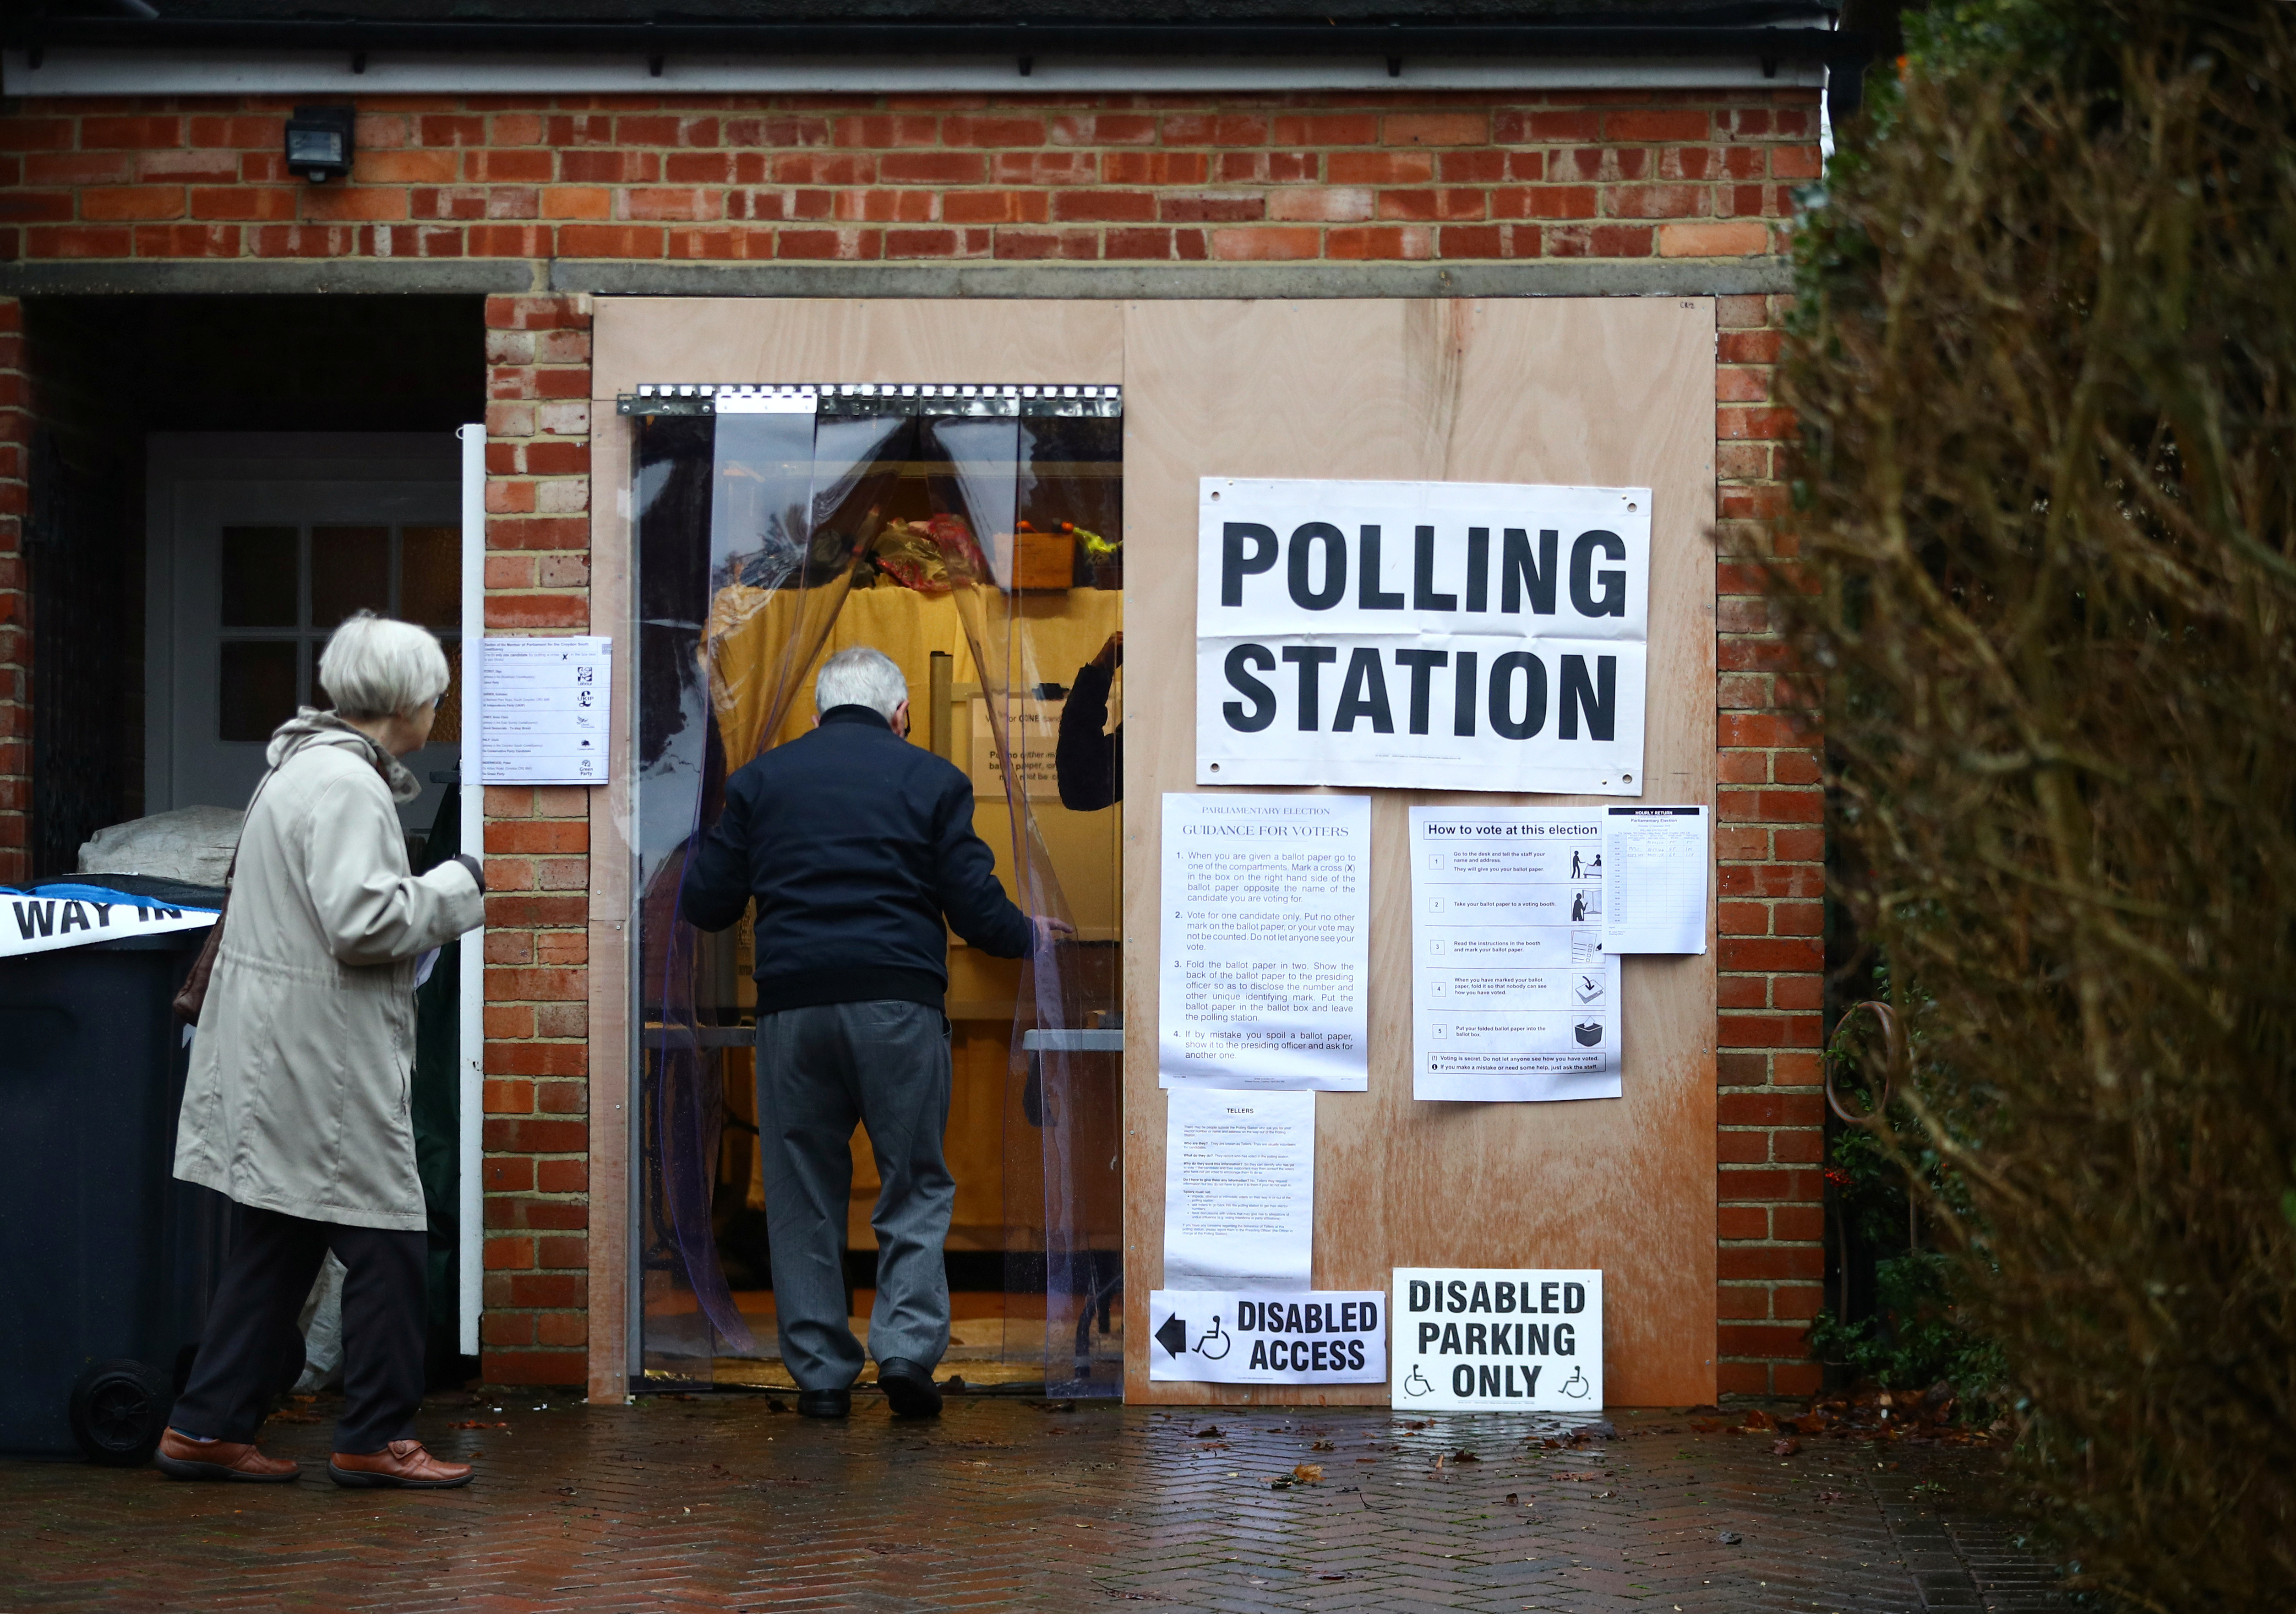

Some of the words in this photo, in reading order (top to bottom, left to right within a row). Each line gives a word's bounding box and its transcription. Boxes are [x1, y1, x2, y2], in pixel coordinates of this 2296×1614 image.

[1222, 522, 1625, 617] POLLING
[1223, 644, 1616, 741] STATION
[1183, 825, 1254, 835] GUIDANCE
[1260, 826, 1287, 836] FOR
[1292, 826, 1348, 836] VOTERS
[1429, 824, 1456, 834] How
[1459, 825, 1472, 834] to
[1476, 825, 1501, 834] vote
[1506, 825, 1517, 835] at
[1521, 824, 1544, 835] this
[1549, 825, 1597, 834] election
[1307, 854, 1331, 863] paper
[1229, 863, 1289, 872] compartments.
[1264, 873, 1282, 883] right
[1243, 884, 1279, 893] opposite
[1263, 894, 1288, 904] voting
[12, 900, 113, 940] WAY
[1195, 1031, 1205, 1039] by
[1266, 1031, 1285, 1040] spoil
[1241, 1041, 1279, 1050] presiding
[1410, 1281, 1584, 1313] DISABLED
[1238, 1301, 1377, 1333] DISABLED
[1419, 1323, 1574, 1355] PARKING
[1249, 1340, 1364, 1371] ACCESS
[1453, 1364, 1541, 1397] ONLY
